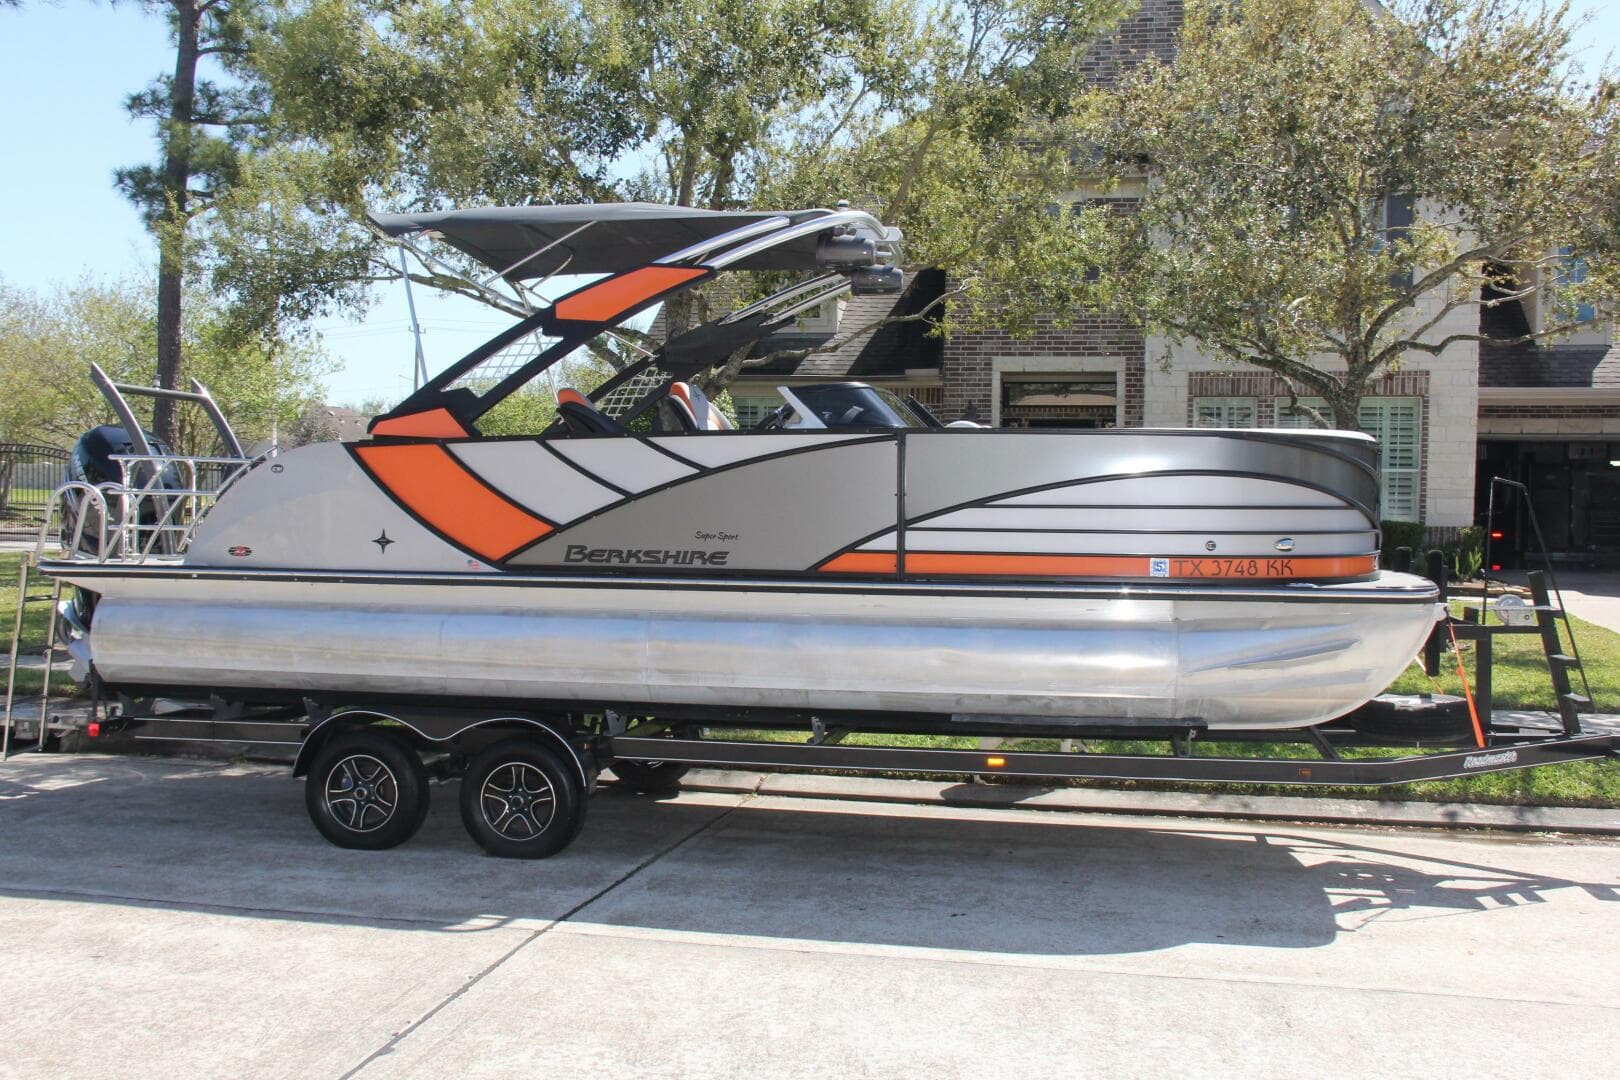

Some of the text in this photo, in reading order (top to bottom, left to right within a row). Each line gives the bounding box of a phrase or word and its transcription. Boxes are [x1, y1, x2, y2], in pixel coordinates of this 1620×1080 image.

[694, 530, 739, 542] Super Sport
[564, 545, 729, 566] BERKSHIRE
[1173, 559, 1294, 577] TX 3748 KK
